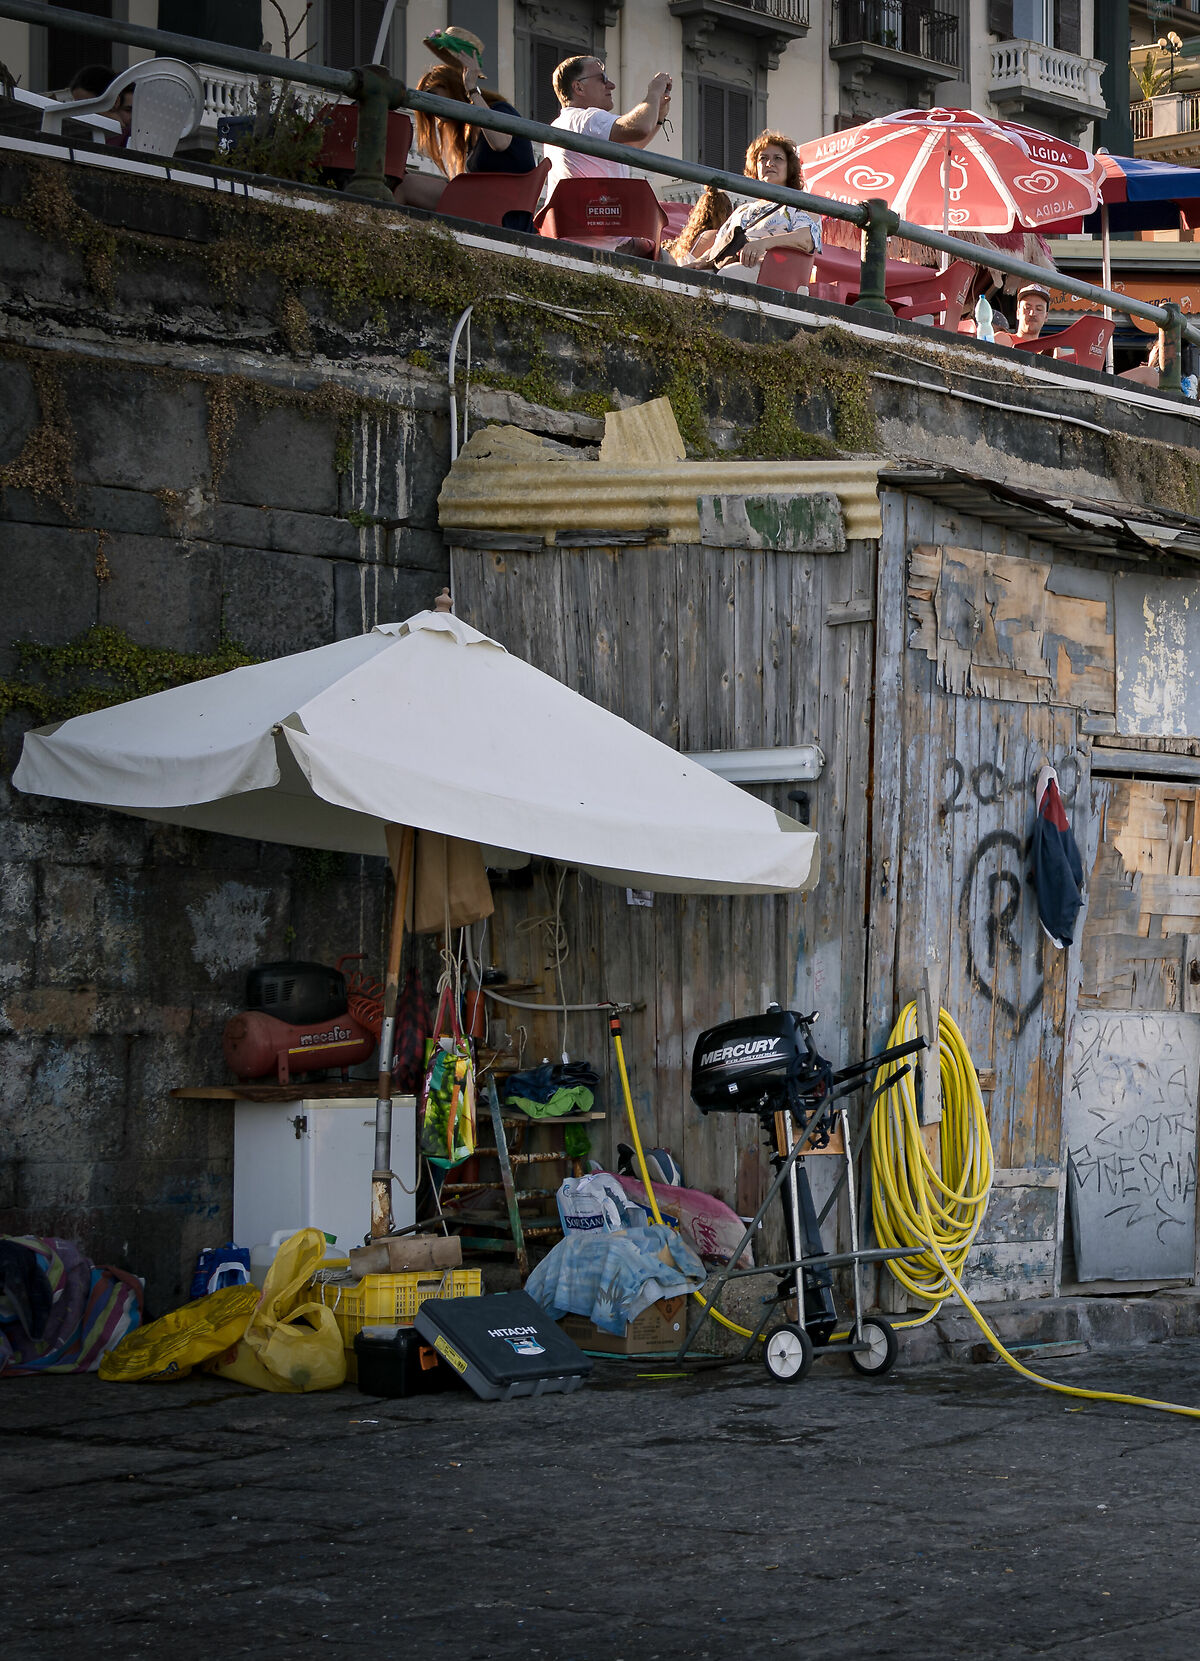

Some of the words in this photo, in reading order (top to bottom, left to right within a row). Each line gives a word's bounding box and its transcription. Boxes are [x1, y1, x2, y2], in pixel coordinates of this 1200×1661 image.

[815, 136, 856, 159] ALGIDA
[588, 207, 620, 215] PERONI
[300, 1026, 352, 1045] mecafer
[700, 1037, 781, 1067] MERCURY
[1067, 1144, 1197, 1203] BRESCIA
[487, 1326, 538, 1338] HITACHI
